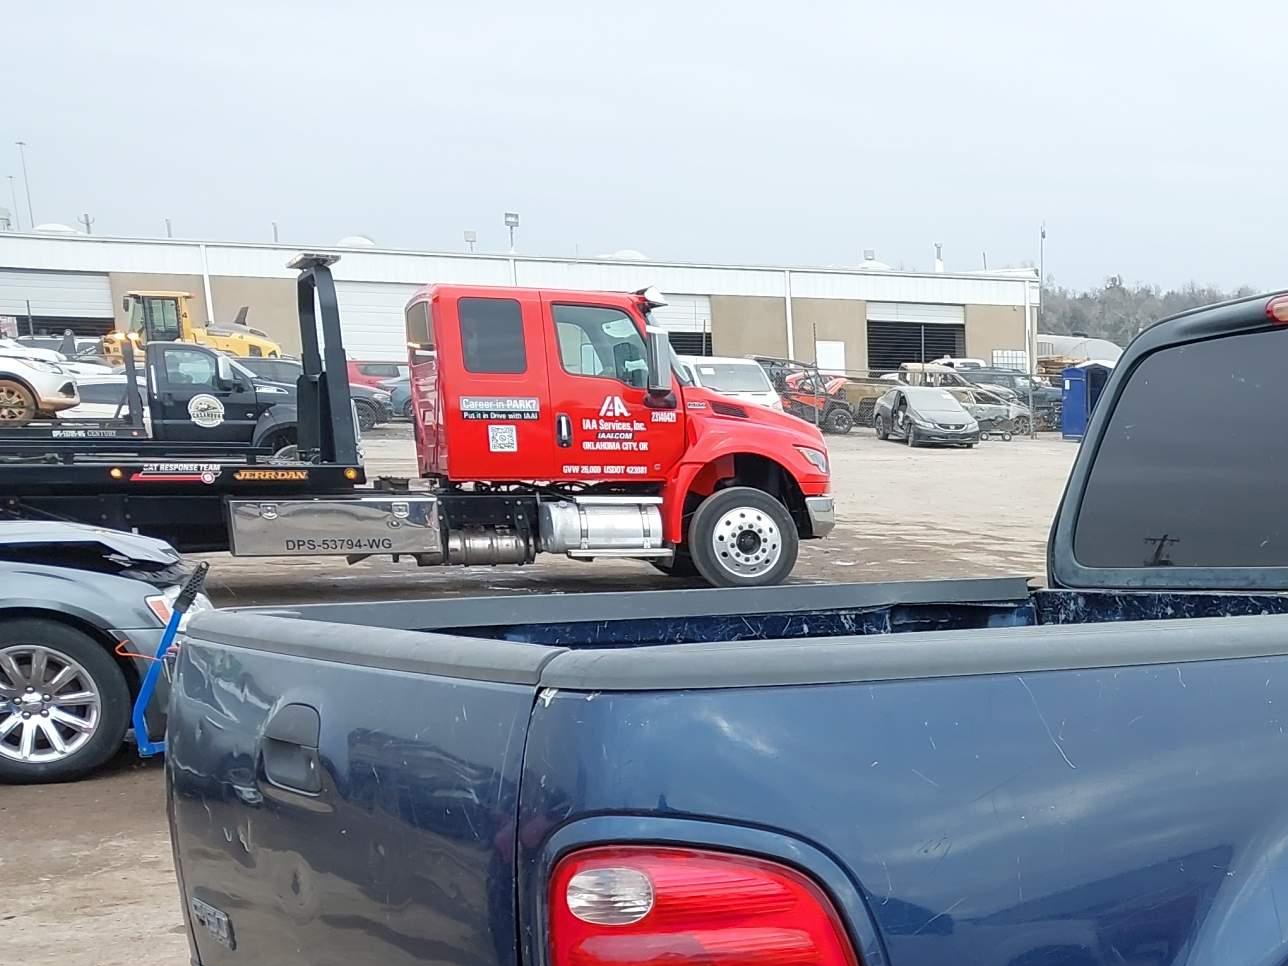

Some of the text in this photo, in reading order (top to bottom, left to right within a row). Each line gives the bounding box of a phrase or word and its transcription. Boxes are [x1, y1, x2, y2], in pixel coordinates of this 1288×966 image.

[507, 400, 537, 409] PARK?
[582, 419, 646, 432] IAA Services, Inc.
[583, 442, 621, 450] OKLAHOMA
[639, 442, 648, 450] OK
[563, 465, 579, 473] GVW
[286, 538, 392, 551] DPS-53794-WG
